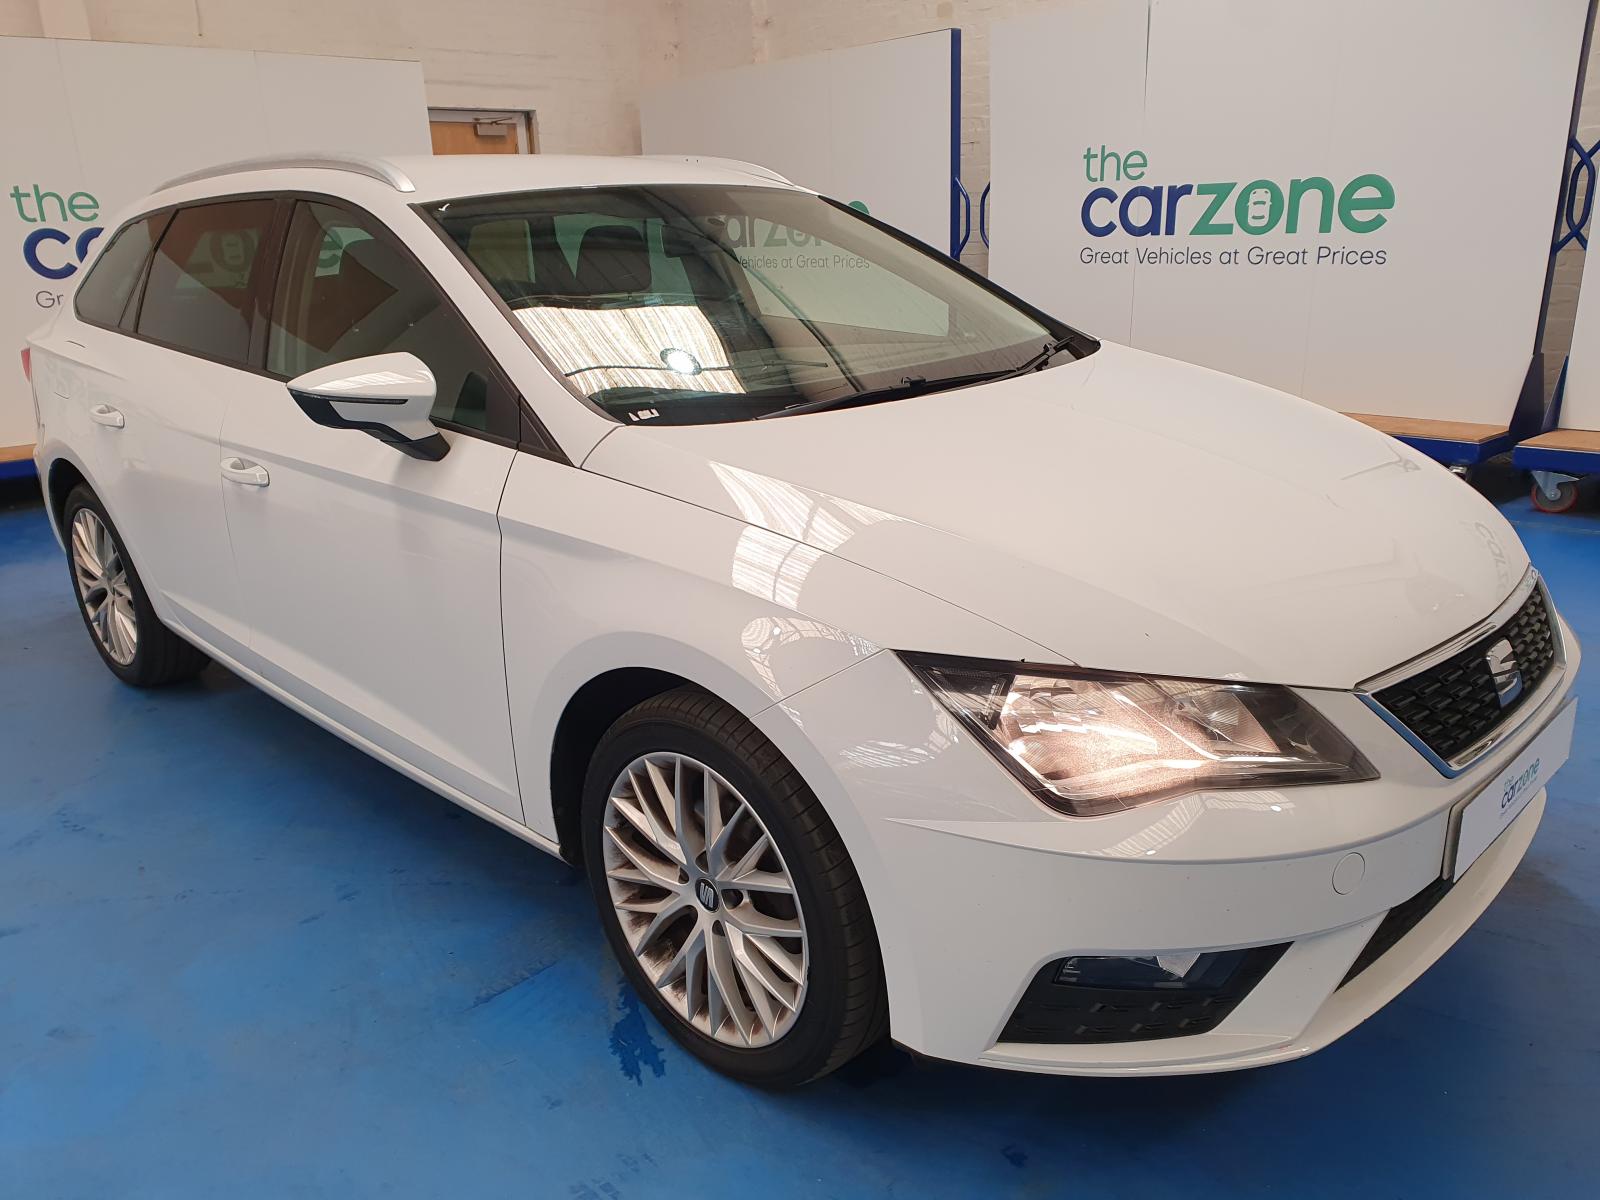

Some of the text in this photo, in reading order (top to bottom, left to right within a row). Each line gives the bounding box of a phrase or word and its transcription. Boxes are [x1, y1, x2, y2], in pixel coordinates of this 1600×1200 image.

[1083, 145, 1148, 182] the
[9, 184, 99, 222] the
[1081, 174, 1396, 237] carzone
[781, 257, 793, 268] at
[796, 255, 828, 269] Great
[1080, 246, 1387, 265] Great Vehicles at Great Prices
